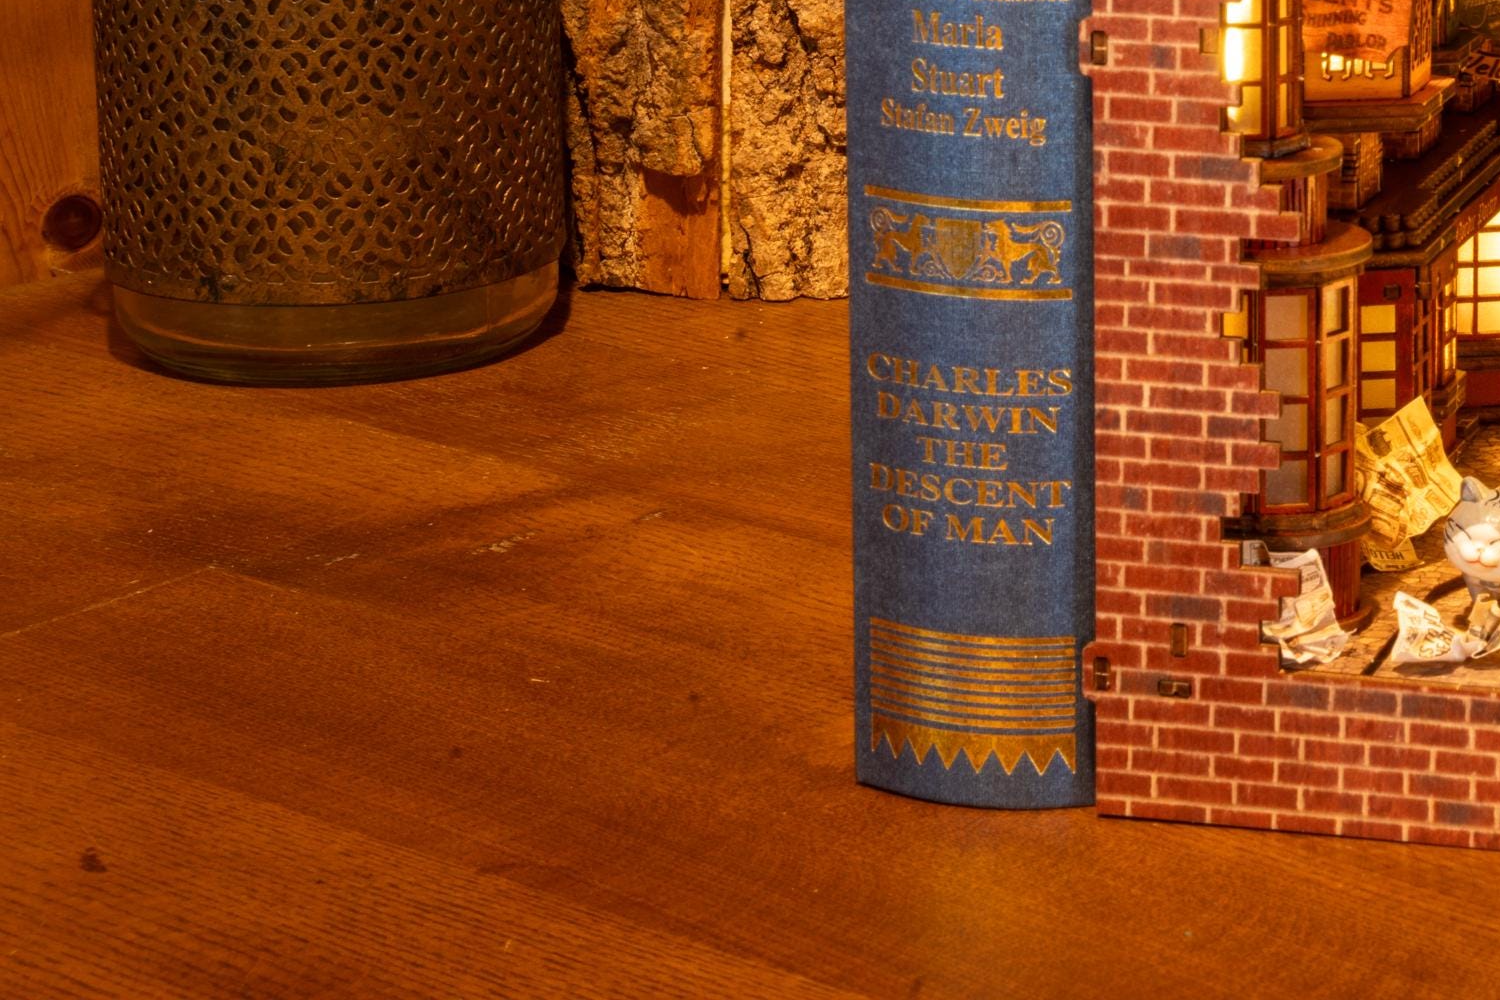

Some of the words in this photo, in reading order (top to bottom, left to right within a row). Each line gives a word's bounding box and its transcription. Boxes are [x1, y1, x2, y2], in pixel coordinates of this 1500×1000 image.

[911, 57, 1005, 99] Stuart
[881, 96, 955, 136] Stafan
[963, 107, 1048, 146] Zweig
[867, 351, 1073, 397] CHARLES
[876, 391, 1061, 434] DARWIN
[916, 435, 1009, 471] THE
[869, 462, 1073, 509] DESCENT
[882, 503, 934, 536] OF
[945, 512, 1056, 546] MAN
